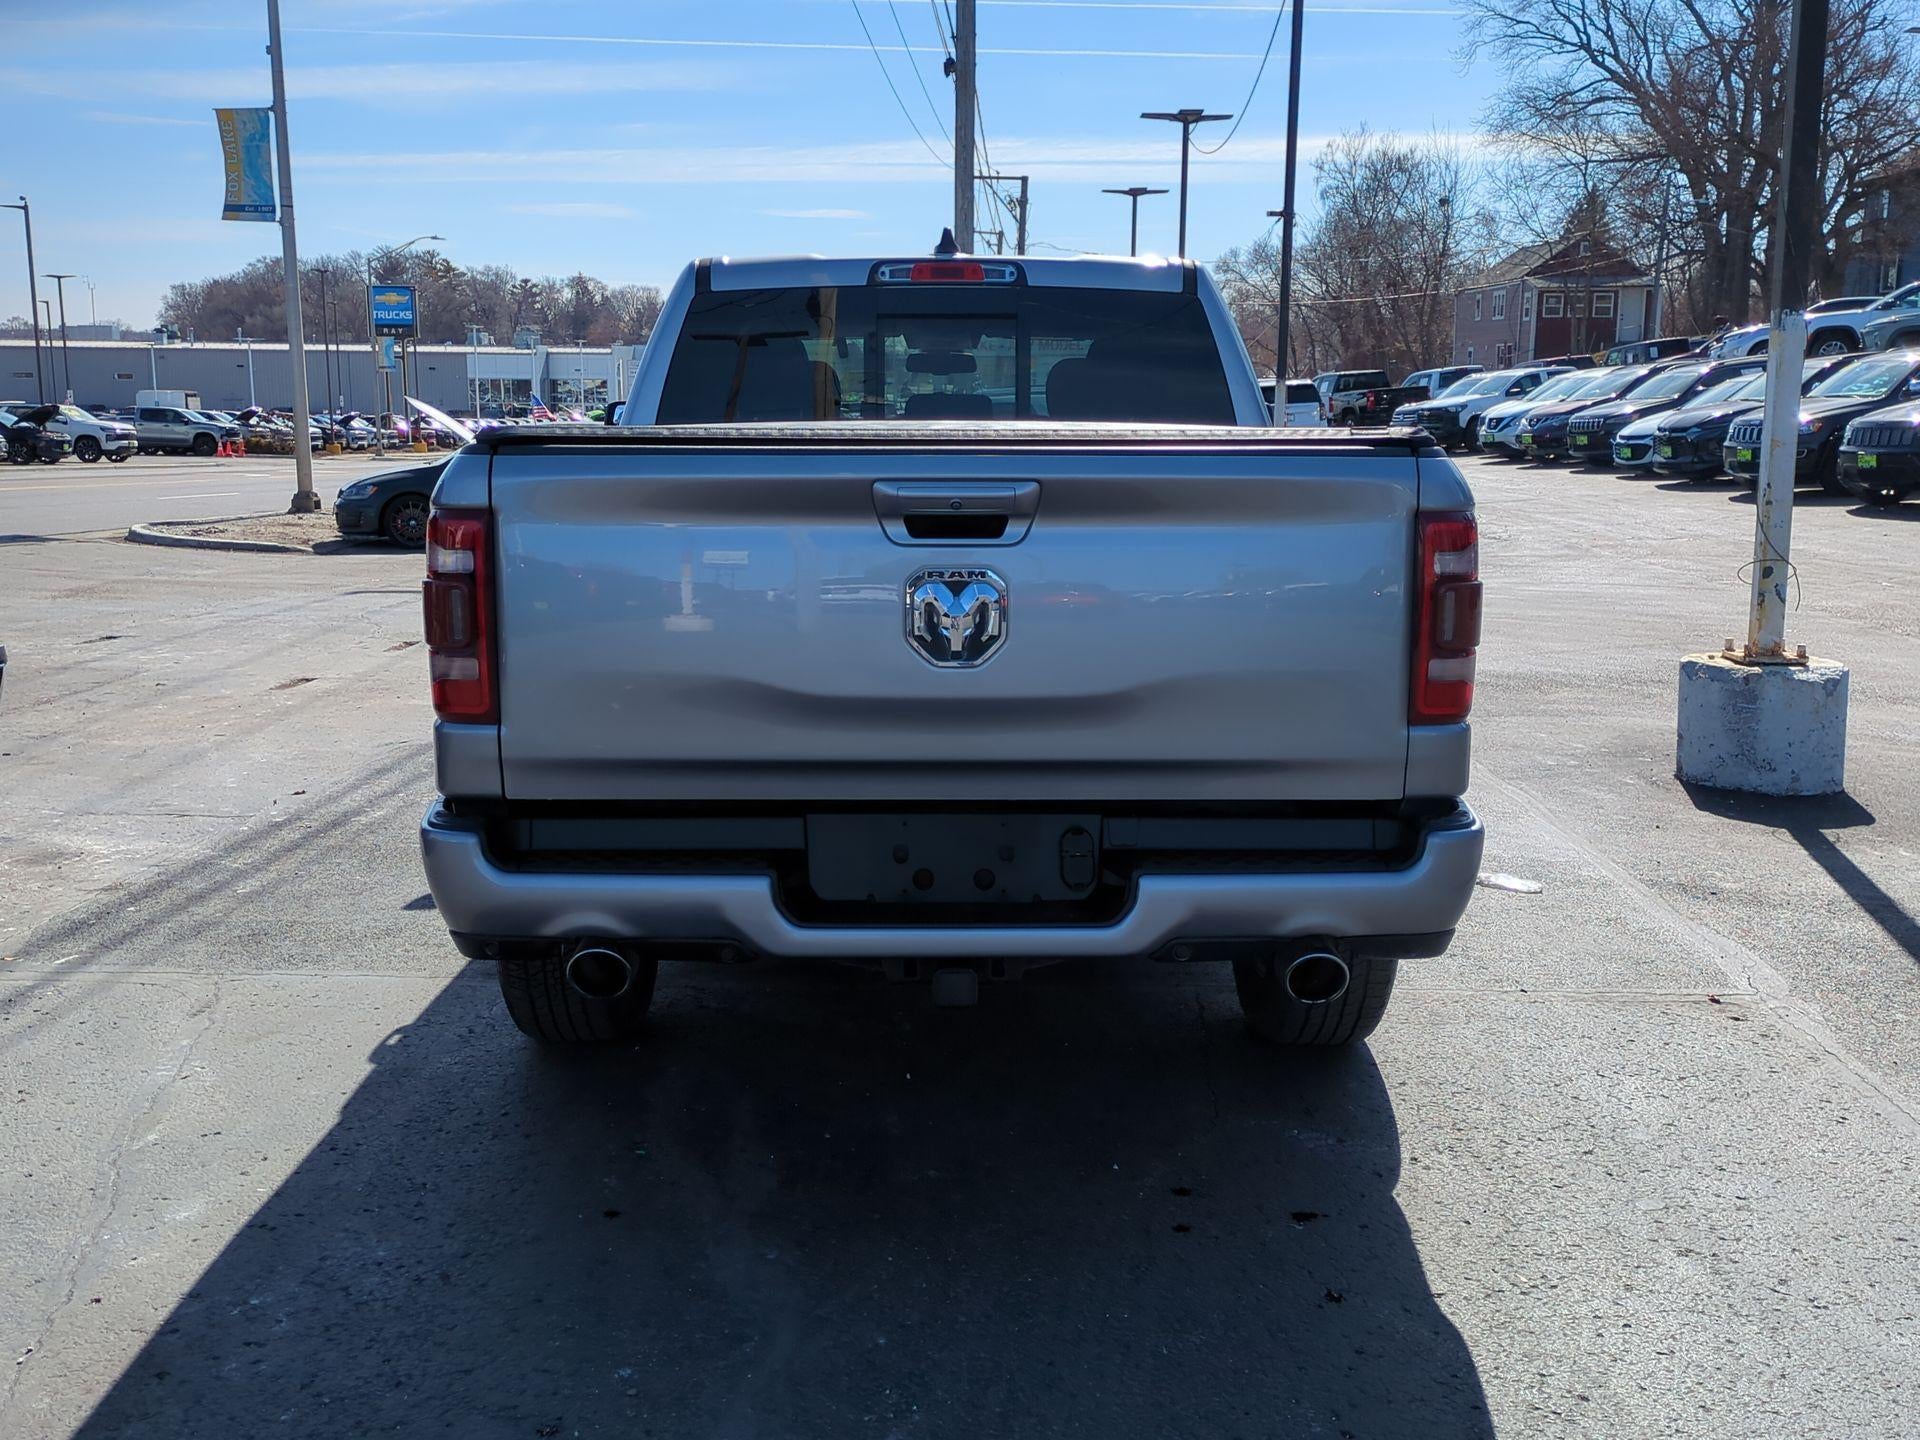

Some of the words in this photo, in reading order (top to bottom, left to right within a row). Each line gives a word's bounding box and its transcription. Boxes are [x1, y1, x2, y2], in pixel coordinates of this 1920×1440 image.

[221, 120, 238, 163] LAKE
[227, 171, 239, 201] FOX
[373, 310, 413, 320] TRUCKS
[925, 570, 987, 579] RAM
